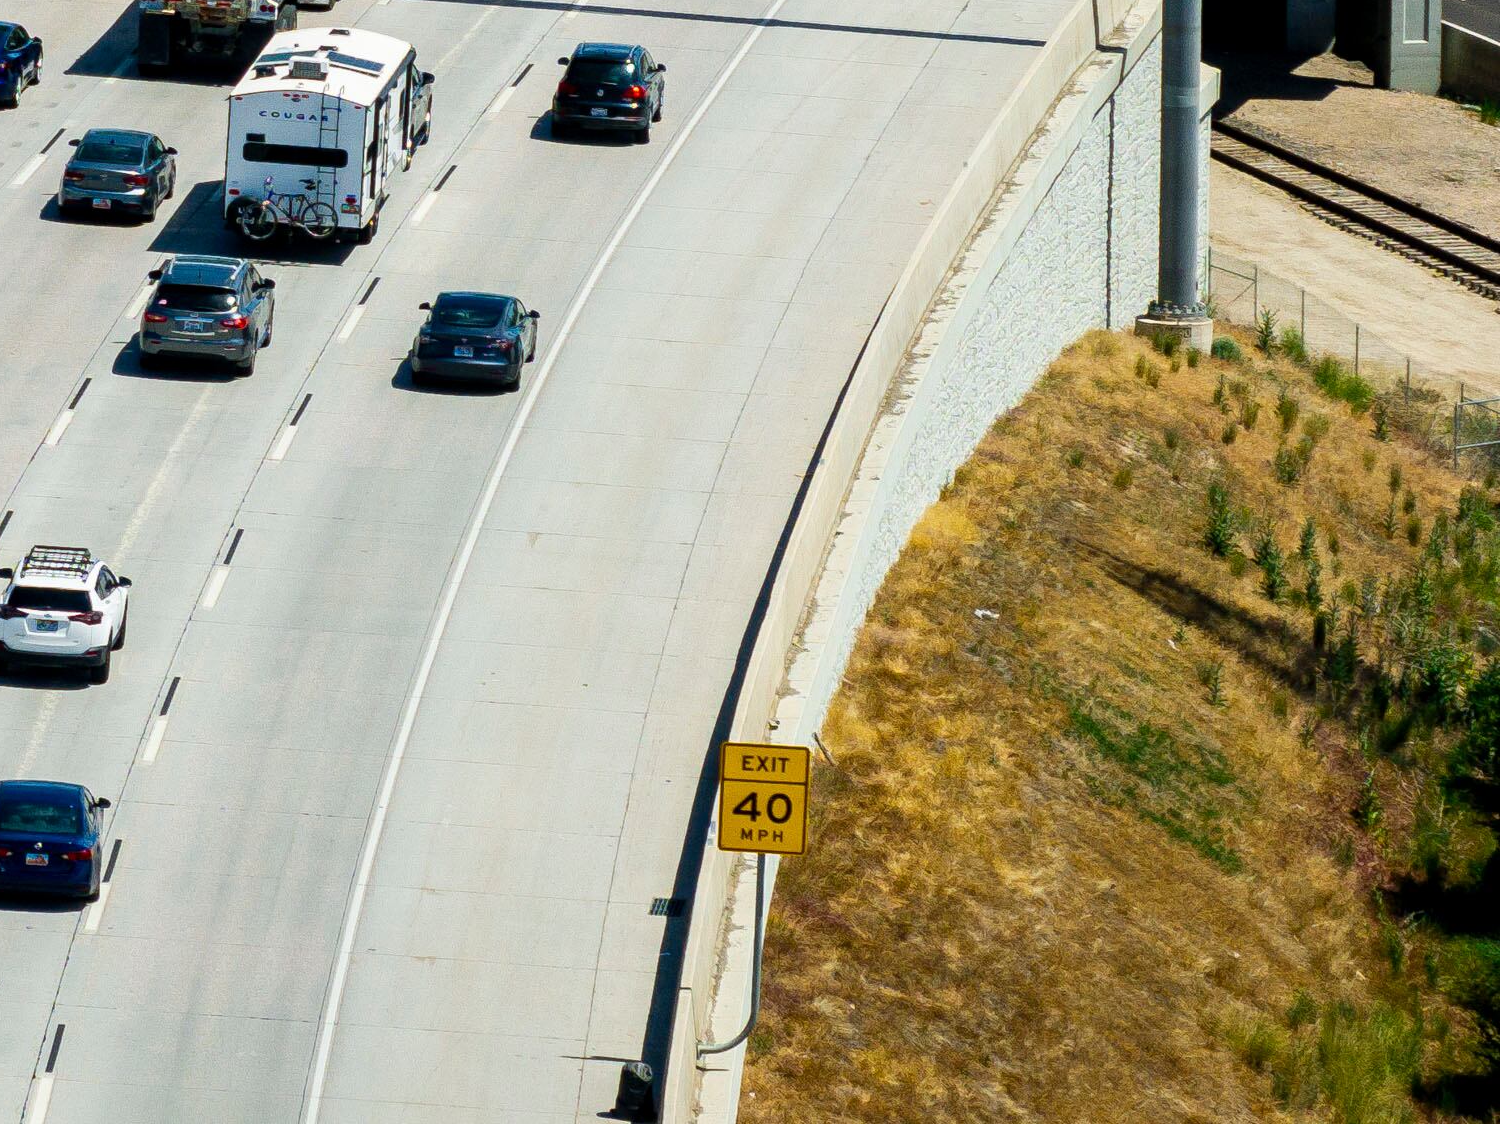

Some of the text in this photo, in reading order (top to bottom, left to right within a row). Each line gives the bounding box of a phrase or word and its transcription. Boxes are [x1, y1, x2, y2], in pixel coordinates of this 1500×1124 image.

[259, 110, 329, 122] COUGAR
[741, 755, 790, 773] EXIT
[732, 791, 793, 824] 40
[740, 828, 784, 843] MPH
